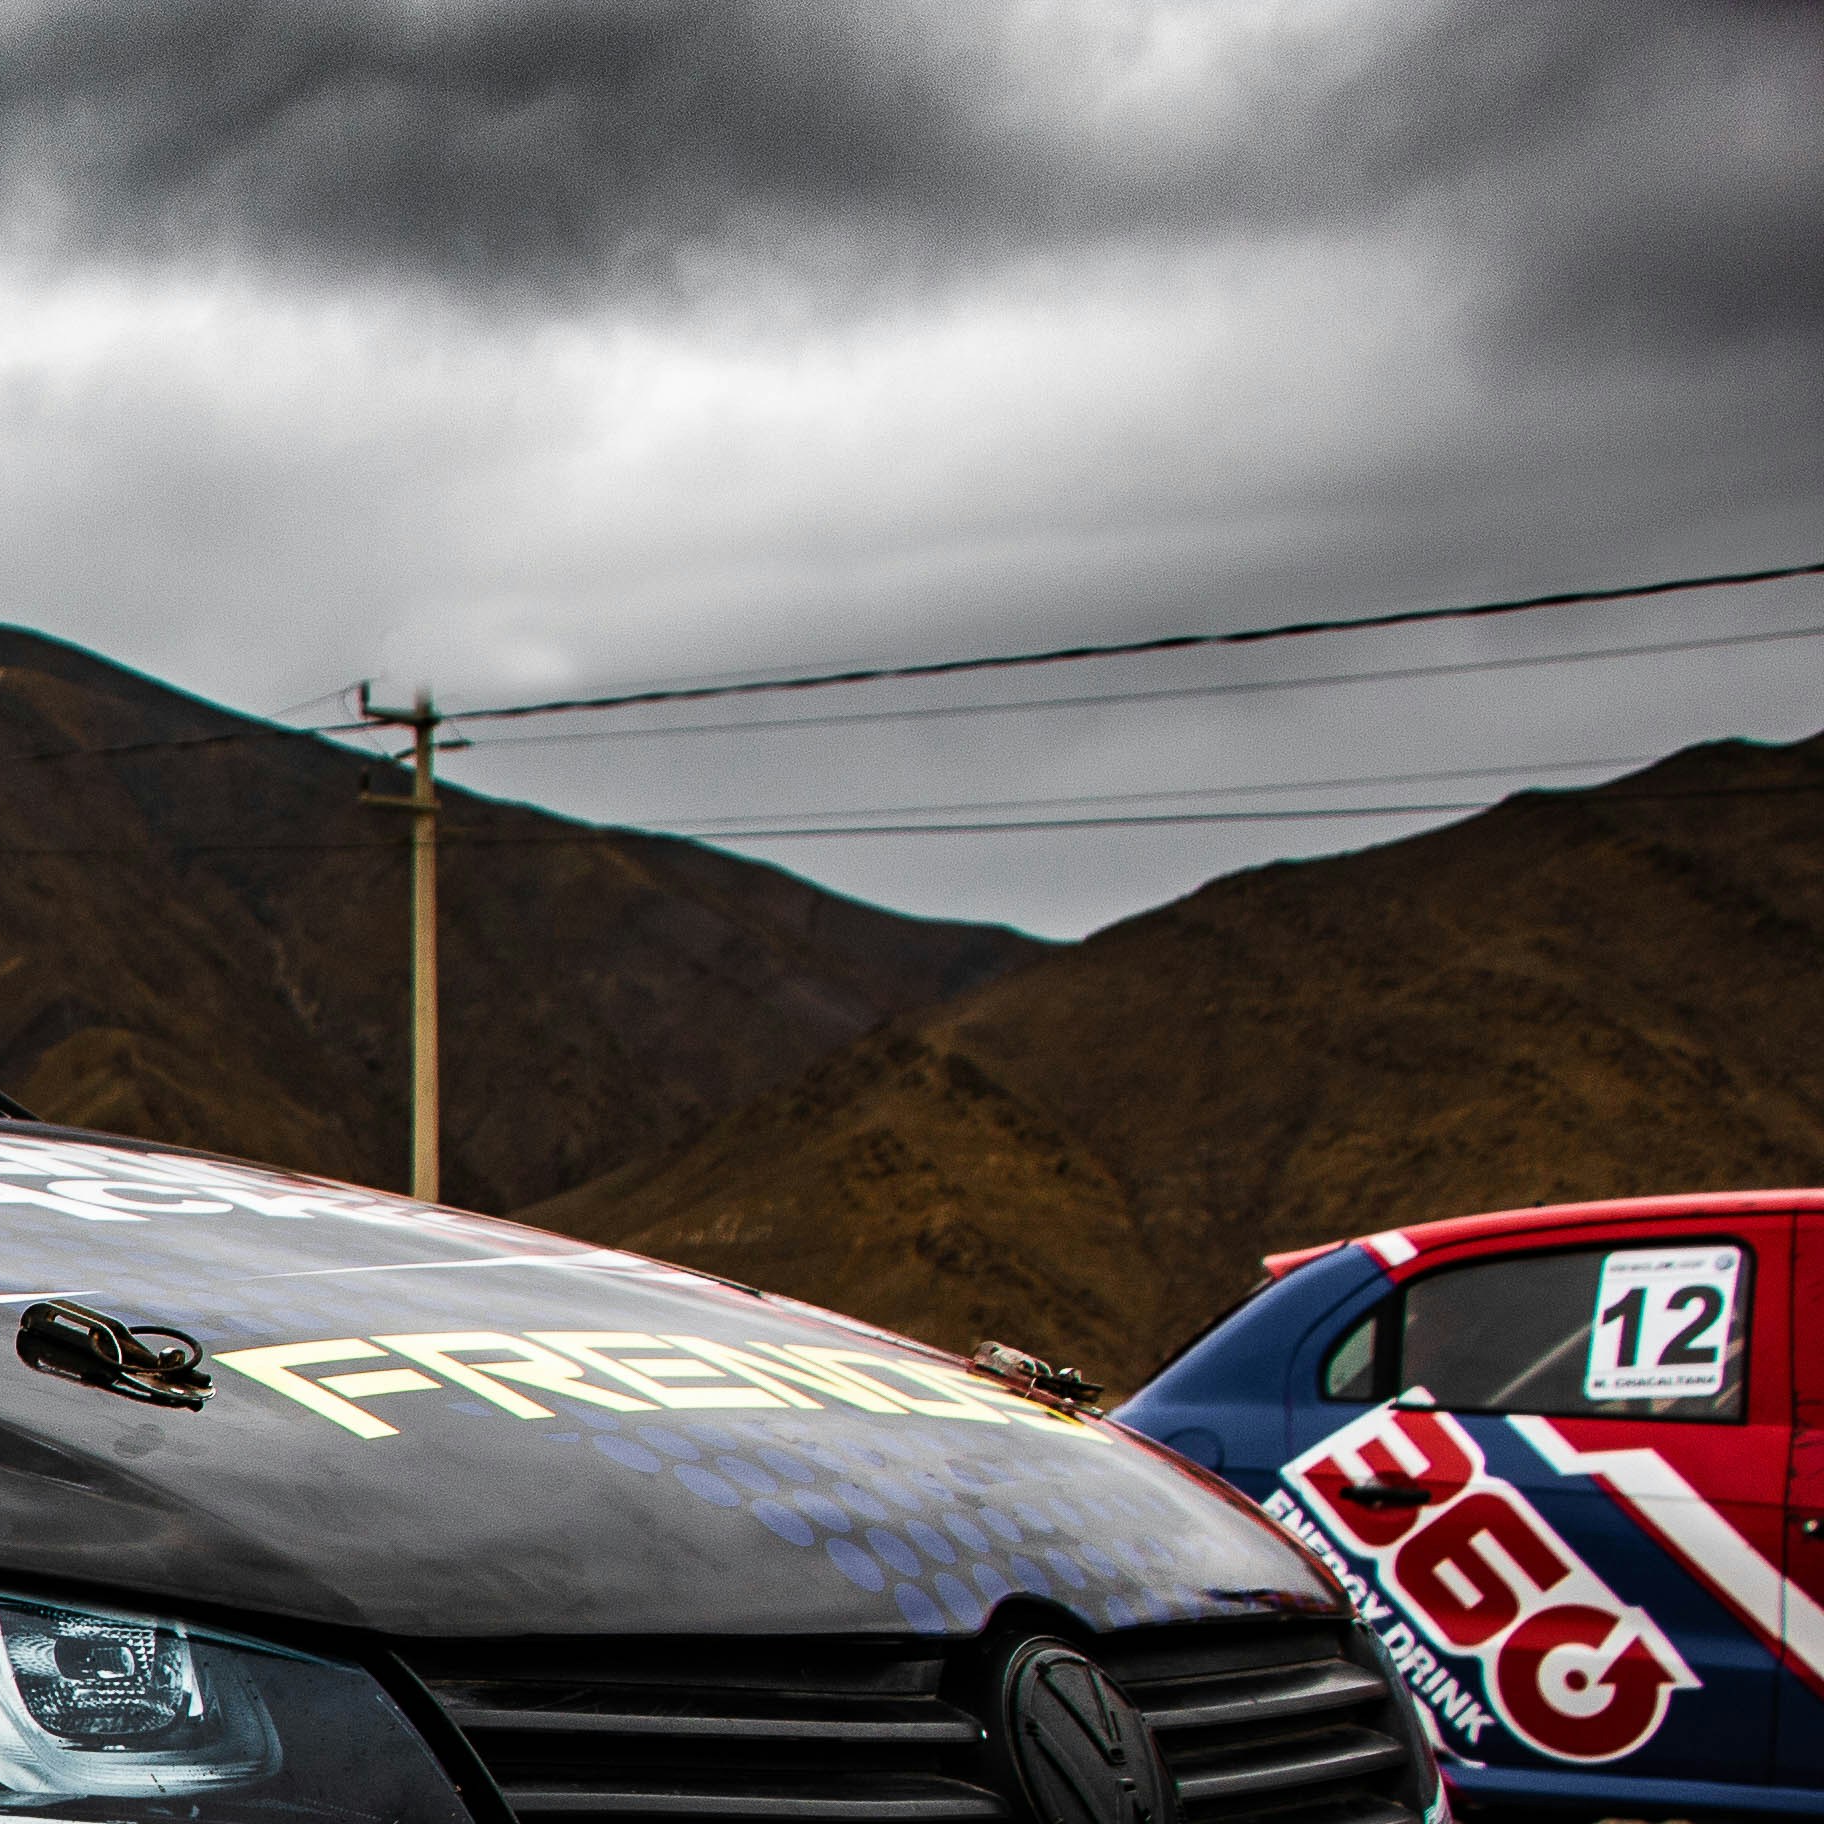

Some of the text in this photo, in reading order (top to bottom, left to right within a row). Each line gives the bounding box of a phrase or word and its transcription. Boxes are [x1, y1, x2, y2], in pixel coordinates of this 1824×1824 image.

[1602, 1285, 1725, 1368] 12
[1297, 1408, 1676, 1756] 360
[1380, 1621, 1497, 1745] DRINK
